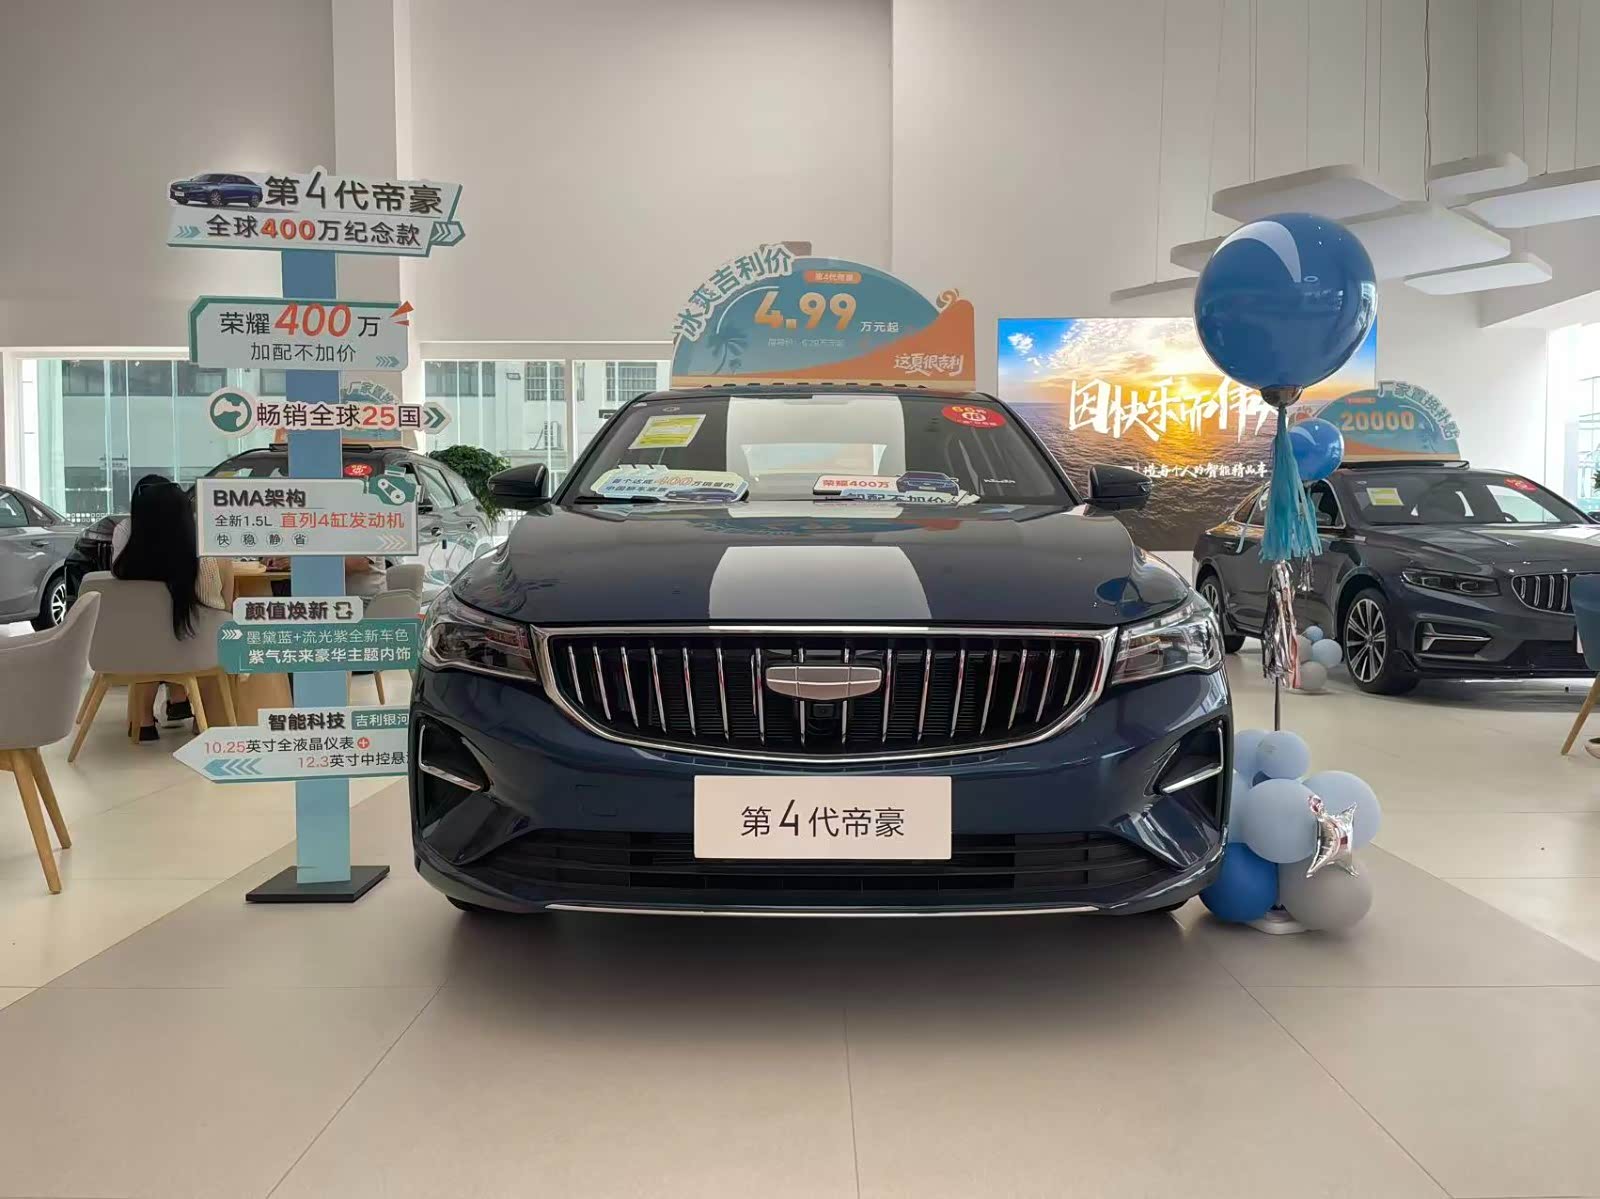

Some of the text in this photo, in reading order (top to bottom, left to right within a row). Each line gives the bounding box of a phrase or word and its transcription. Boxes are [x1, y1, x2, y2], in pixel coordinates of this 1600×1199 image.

[264, 172, 442, 214] 第4代帝豪
[207, 214, 421, 246] 全球400万纪念款
[673, 247, 792, 336] 冰爽吉利价
[219, 302, 381, 338] 荣耀400万
[754, 291, 857, 330] 4.99
[860, 321, 899, 333] 万元起
[250, 343, 356, 364] 加配不加价
[893, 353, 964, 377] 这夏很吉利
[256, 403, 421, 428] 畅销全球25国
[1341, 411, 1415, 431] 20000
[822, 479, 890, 489] 荣耀400万
[213, 488, 307, 508] BMA架构
[215, 512, 405, 530] 全新1.5L 直列4缸发动机
[217, 533, 307, 547] 快 稳 静 省
[245, 601, 329, 622] 颜值焕新
[246, 628, 409, 646] 墨黛蓝+流光紫全新车色
[248, 646, 411, 665] 紫气东来豪华主题内饰
[268, 712, 409, 732] 智能科技 吉利银河
[204, 736, 354, 755] 10.25英寸全液晶仪表
[297, 752, 409, 769] 12.3英寸中控悬
[741, 799, 905, 838] 第4代帝豪
